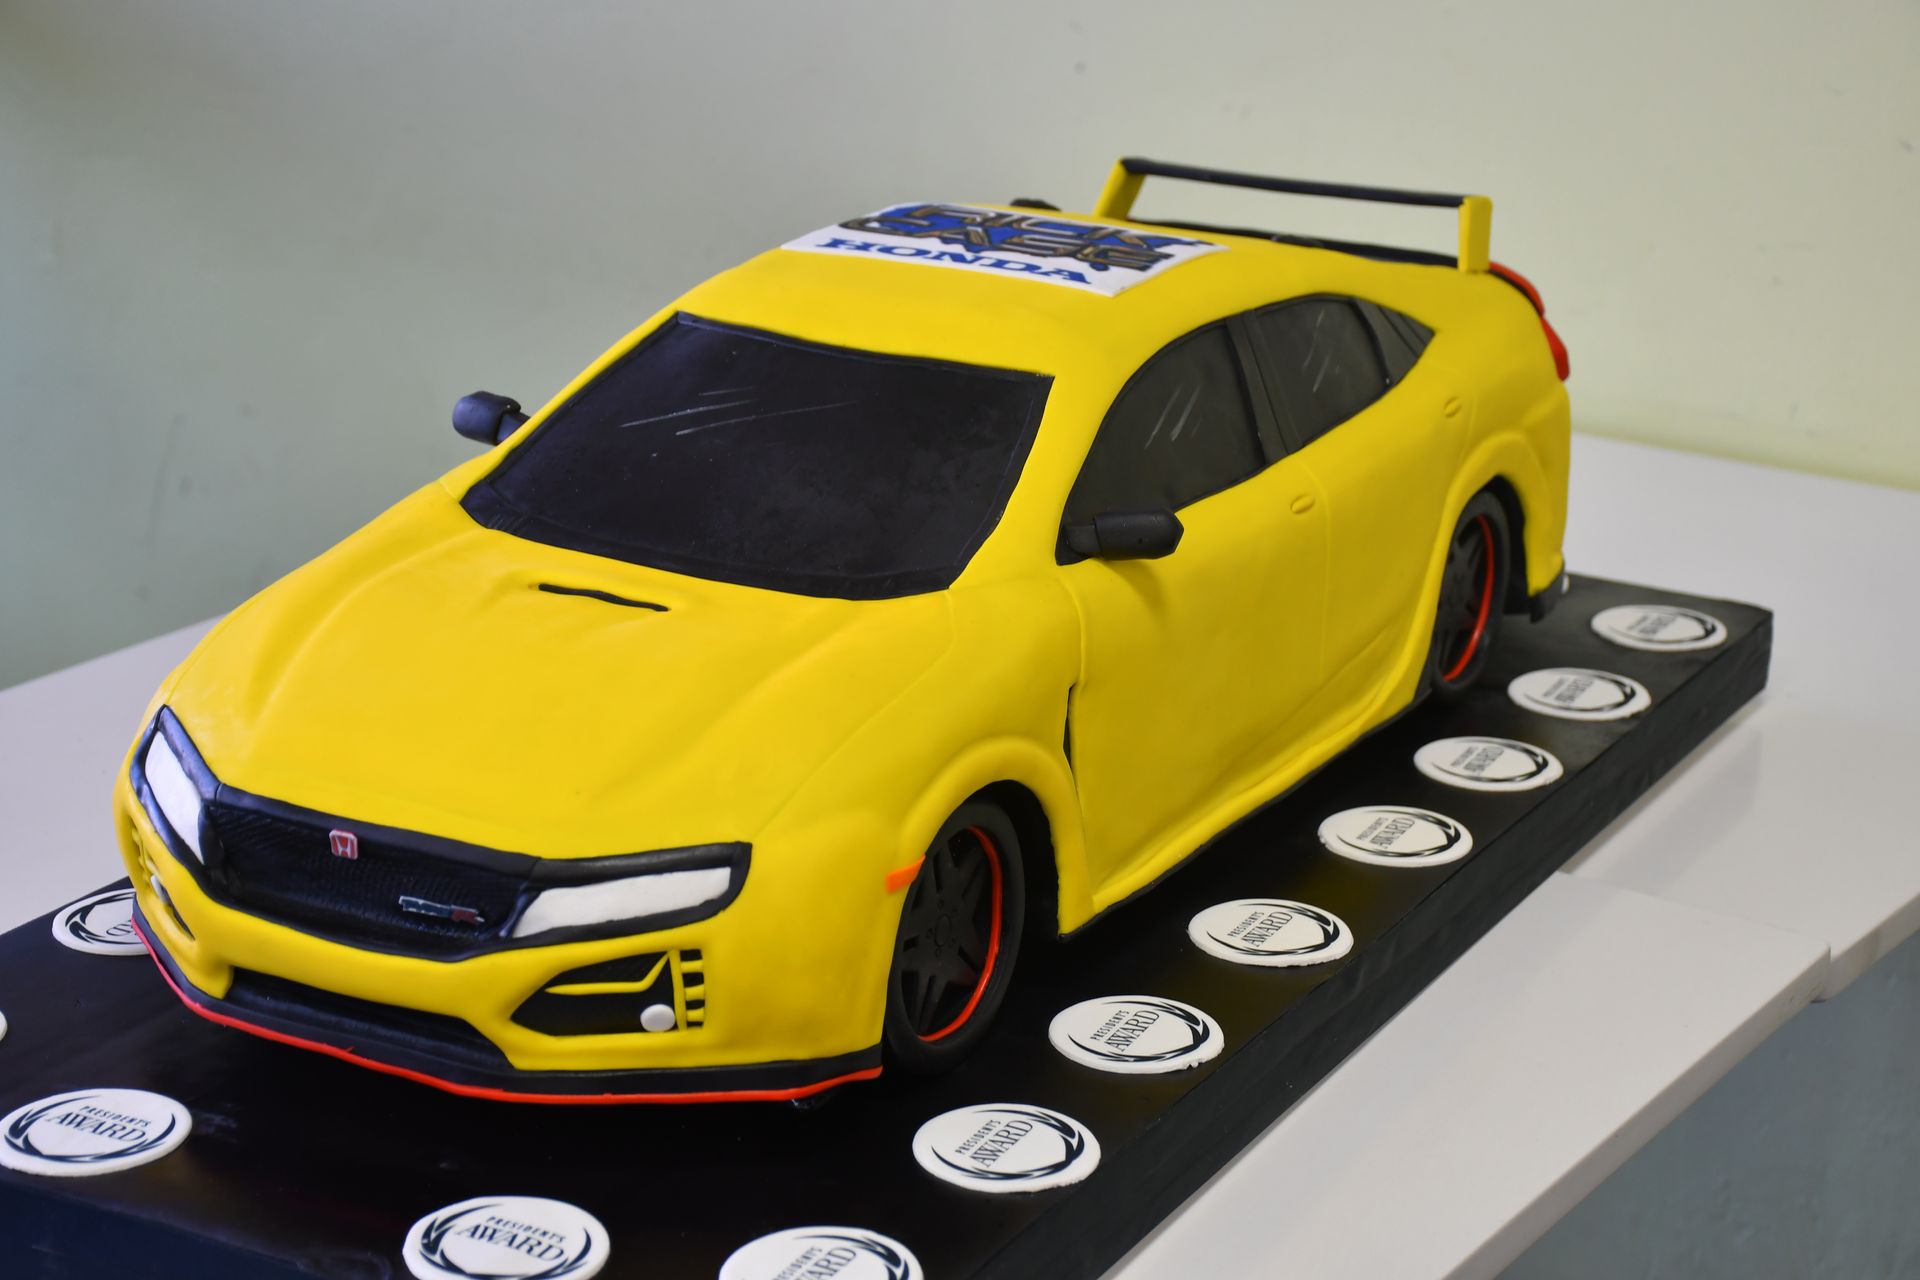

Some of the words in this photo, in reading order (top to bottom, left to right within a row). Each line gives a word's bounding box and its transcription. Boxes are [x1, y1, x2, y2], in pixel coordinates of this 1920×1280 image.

[816, 237, 1092, 285] HONDA
[1241, 911, 1293, 947] AWARD
[1103, 1010, 1160, 1052] AWARD
[47, 1111, 147, 1142] AWARD
[969, 1119, 1034, 1168] AWARD
[456, 1223, 565, 1261] AWARD
